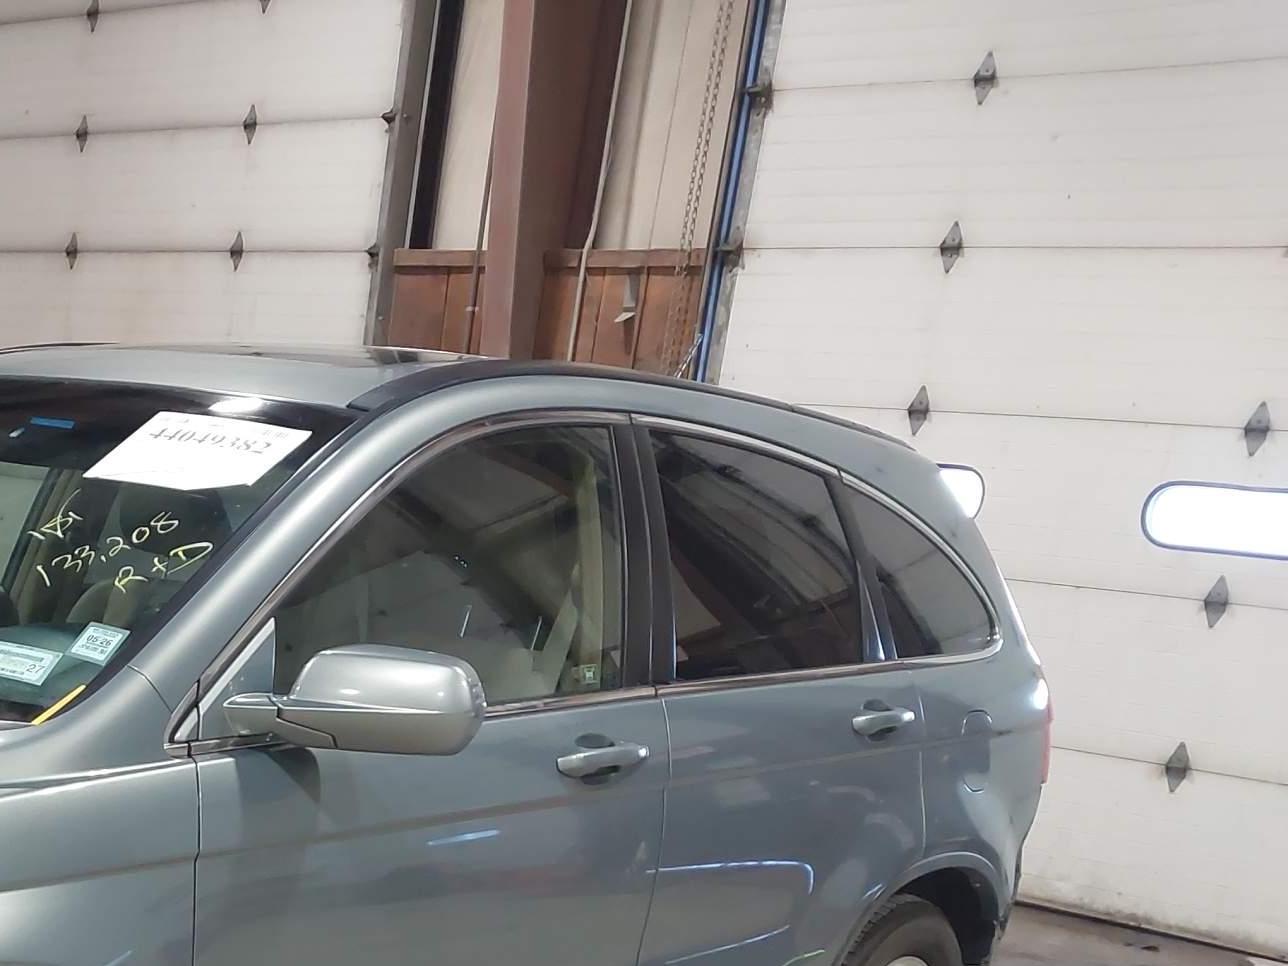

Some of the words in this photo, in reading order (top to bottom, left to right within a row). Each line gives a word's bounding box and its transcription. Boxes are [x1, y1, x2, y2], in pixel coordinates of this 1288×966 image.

[149, 427, 274, 454] 44049382
[36, 511, 179, 588] 133,208
[26, 663, 46, 674] 27
